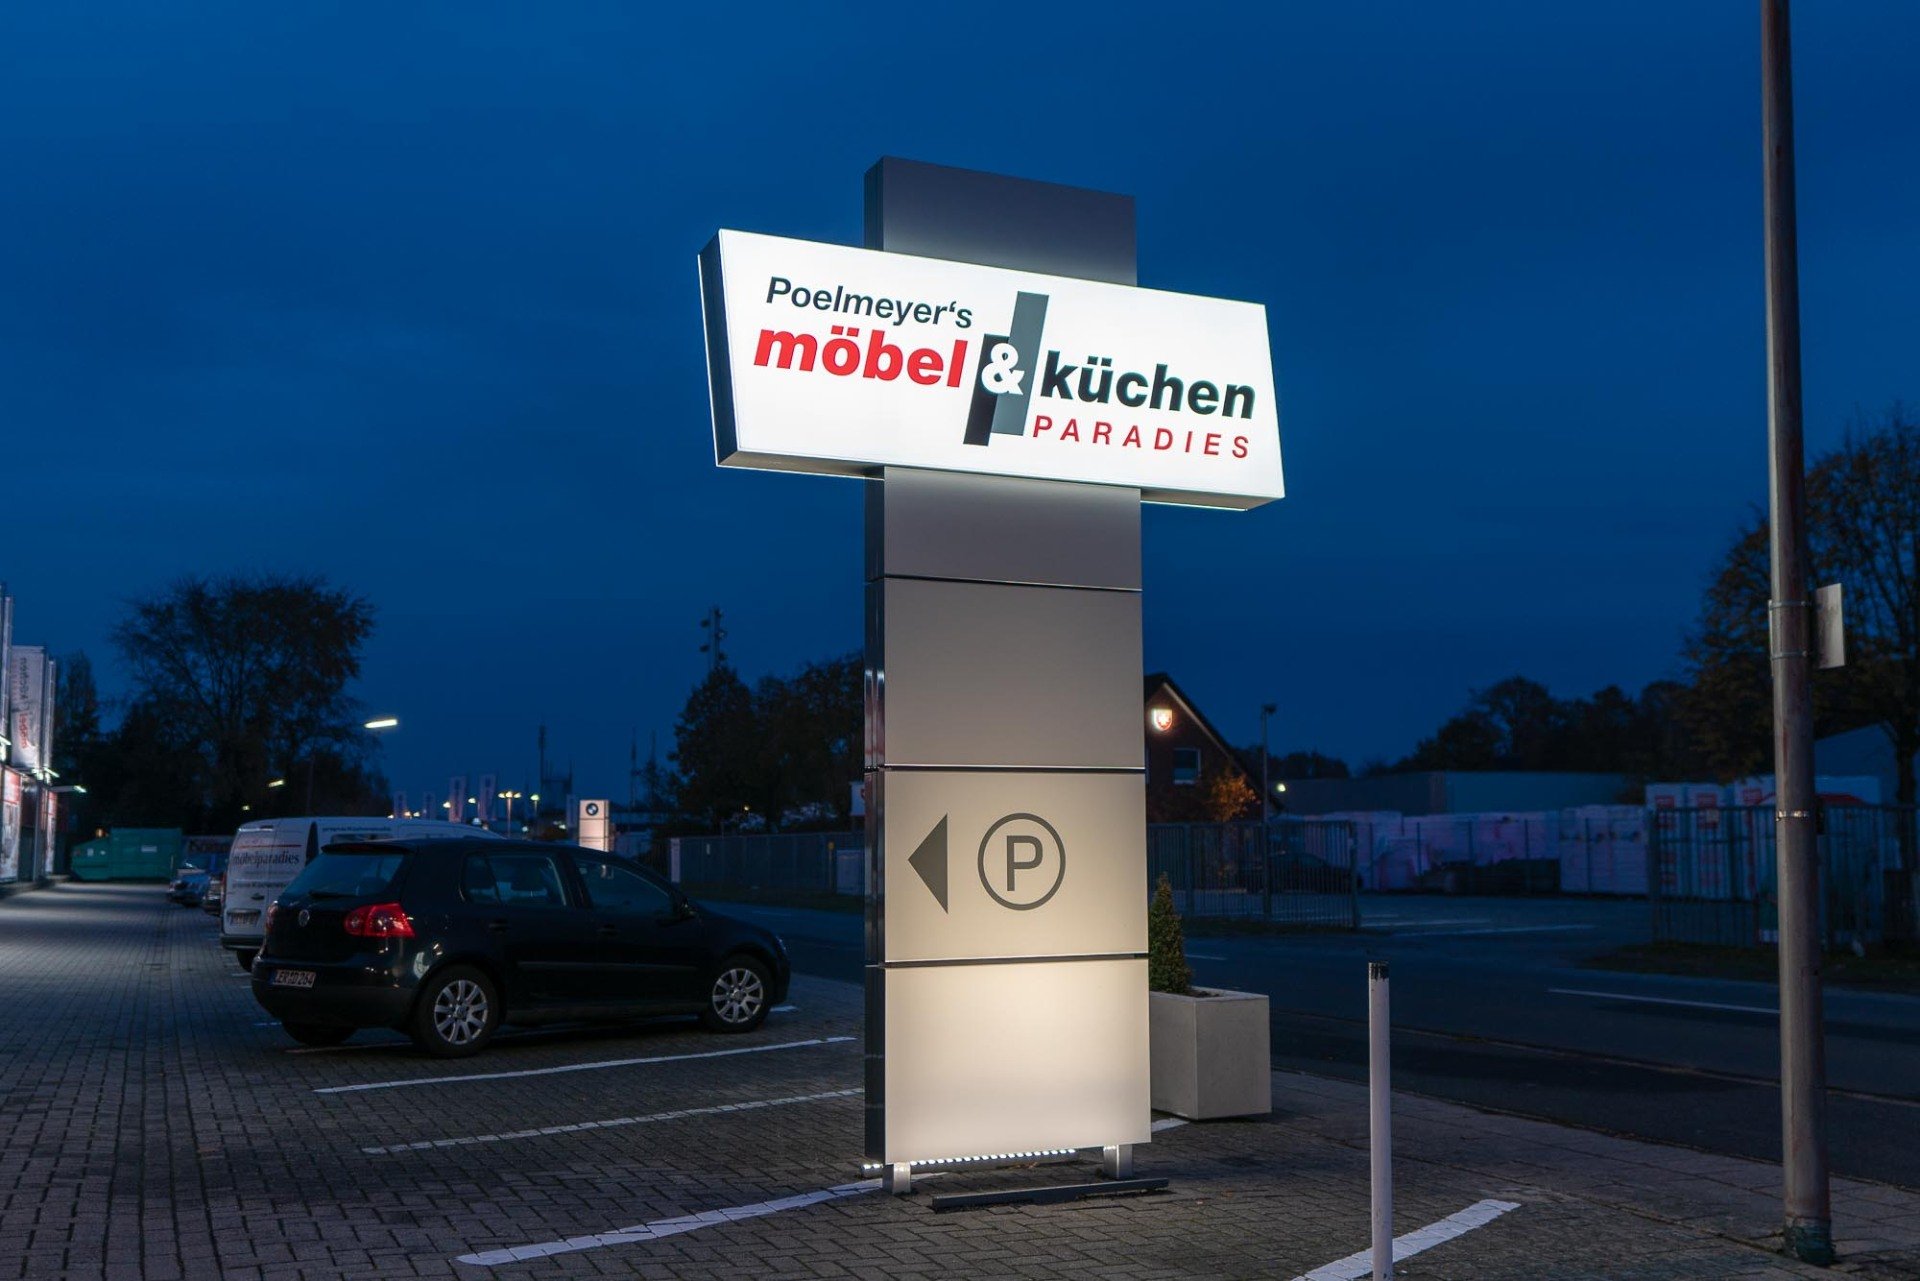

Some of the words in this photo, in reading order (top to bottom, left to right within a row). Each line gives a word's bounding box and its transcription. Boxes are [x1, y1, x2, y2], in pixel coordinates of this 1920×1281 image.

[753, 325, 968, 388] möbel
[981, 343, 1025, 396] &
[1040, 349, 1256, 419] küchen
[1032, 415, 1250, 459] PARADIES
[1006, 835, 1043, 891] P
